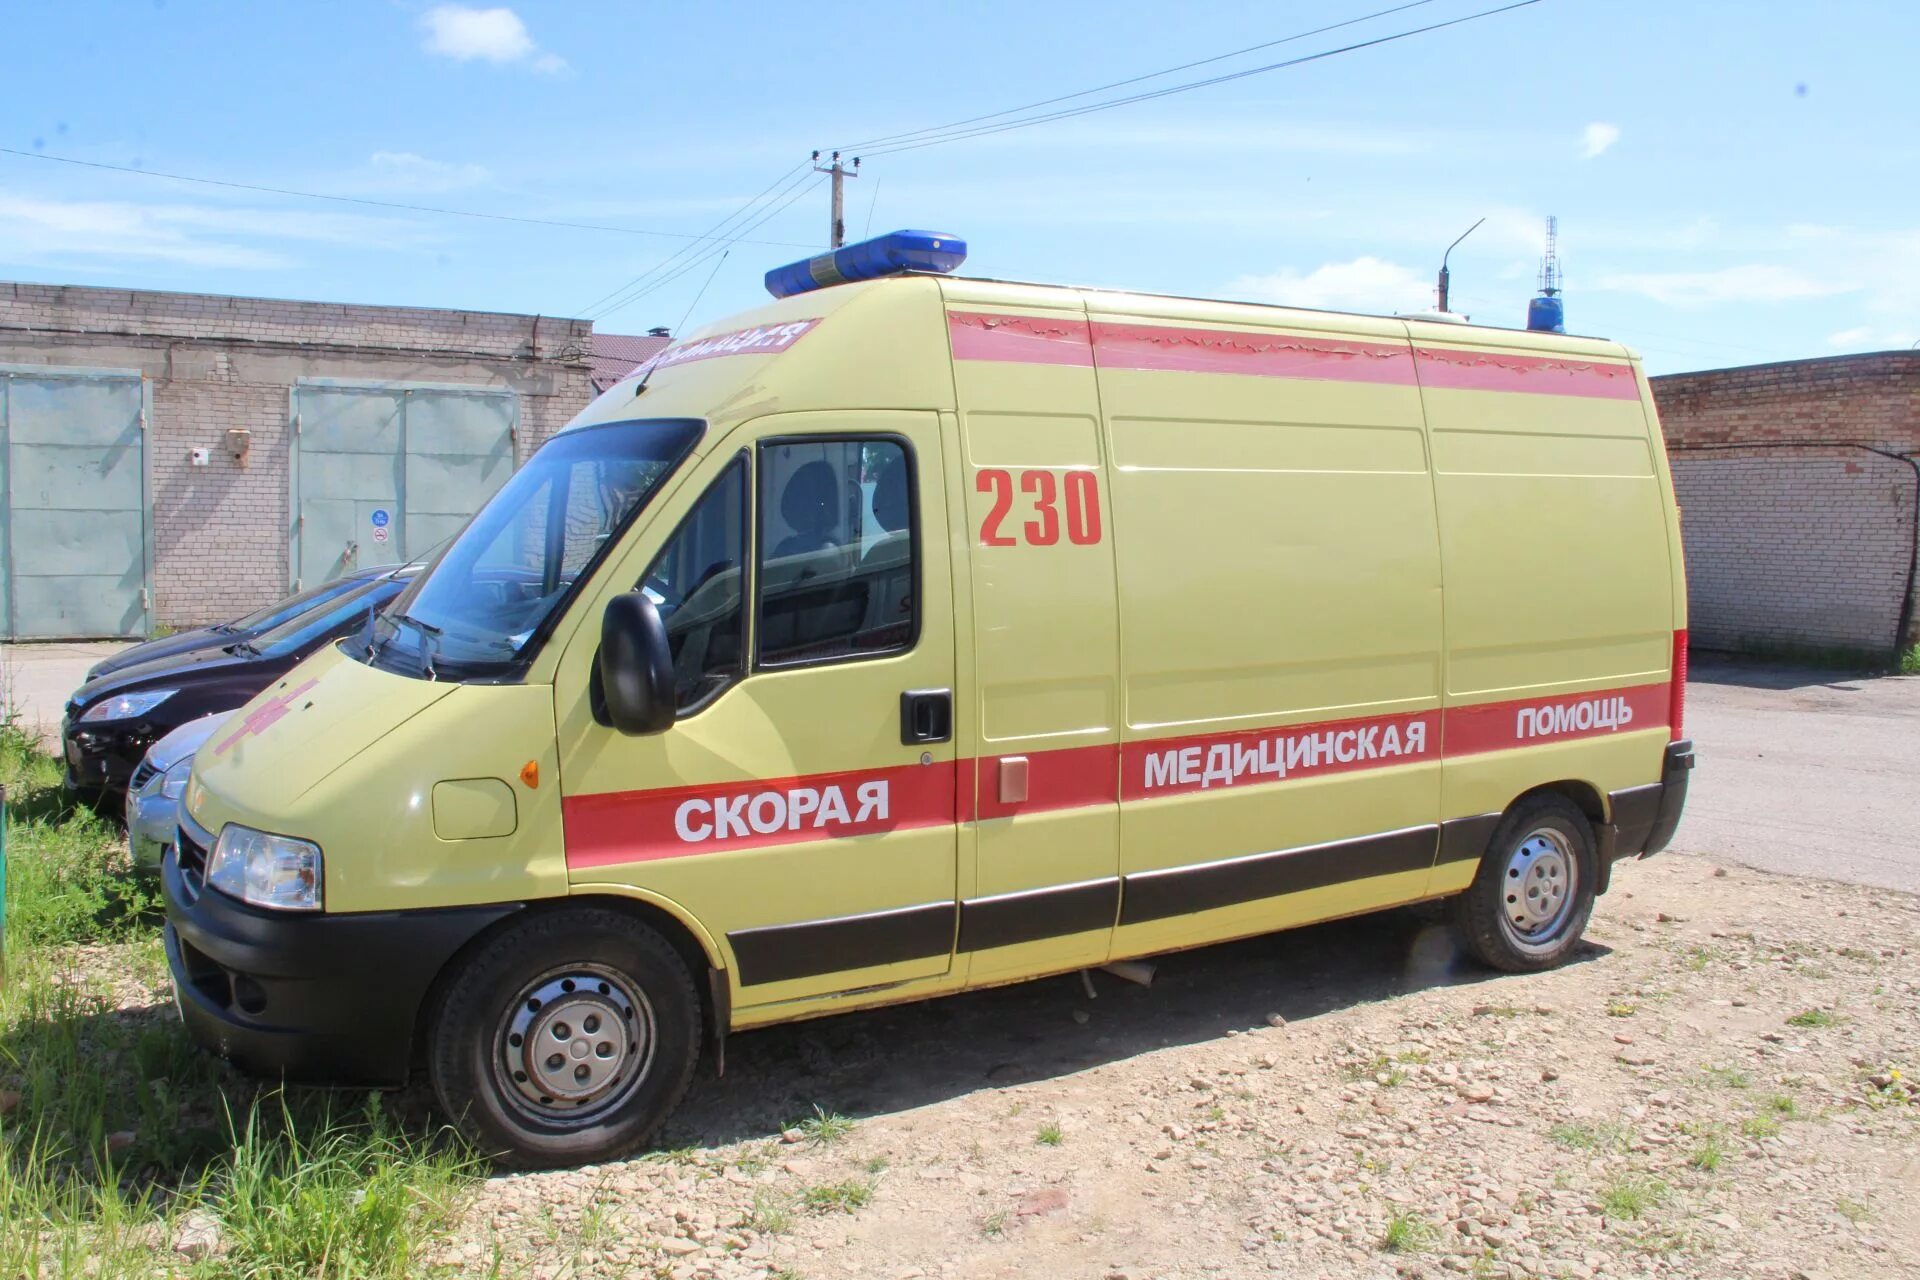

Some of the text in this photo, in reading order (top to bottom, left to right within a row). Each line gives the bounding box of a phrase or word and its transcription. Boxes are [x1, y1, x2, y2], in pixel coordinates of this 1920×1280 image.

[976, 469, 1101, 546] 230
[675, 696, 1632, 842] СКОРАЯ МЕДИЦИНСКАЯ ПОМОЩЬ
